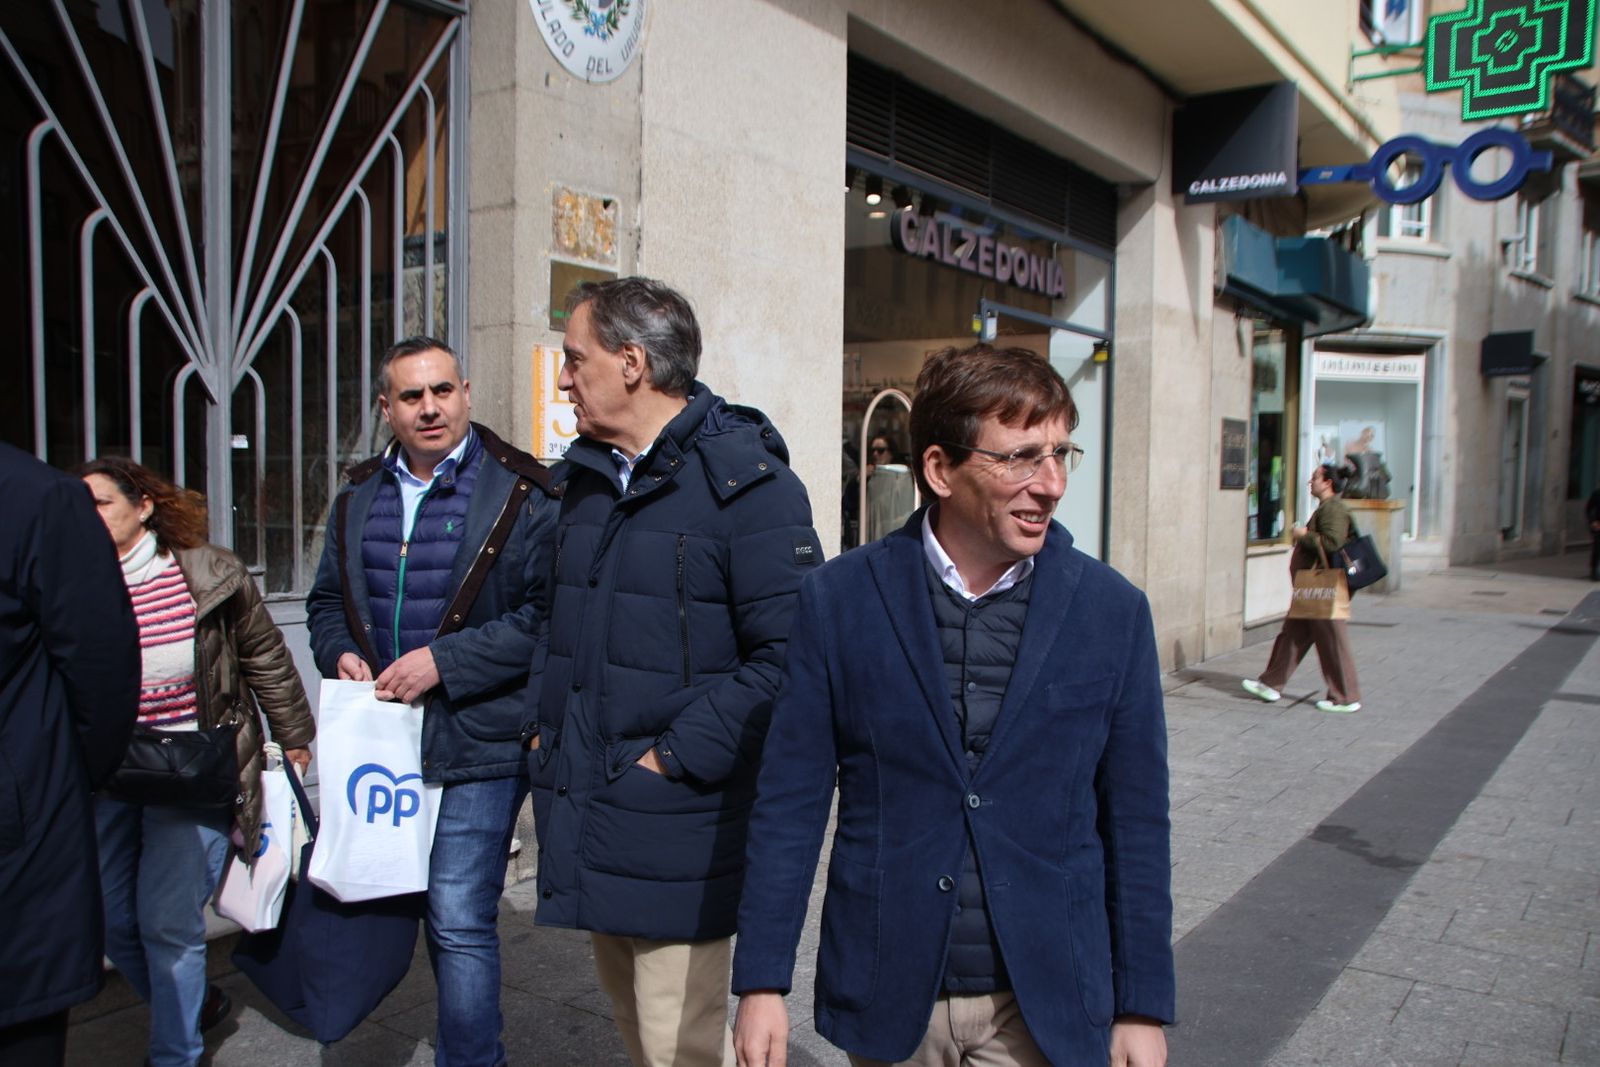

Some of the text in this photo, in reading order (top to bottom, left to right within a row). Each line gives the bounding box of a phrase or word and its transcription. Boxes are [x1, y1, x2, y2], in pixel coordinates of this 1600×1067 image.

[586, 54, 613, 75] DEL
[1188, 171, 1287, 195] CALZEDONIA
[896, 209, 1067, 298] CALZEDONIA
